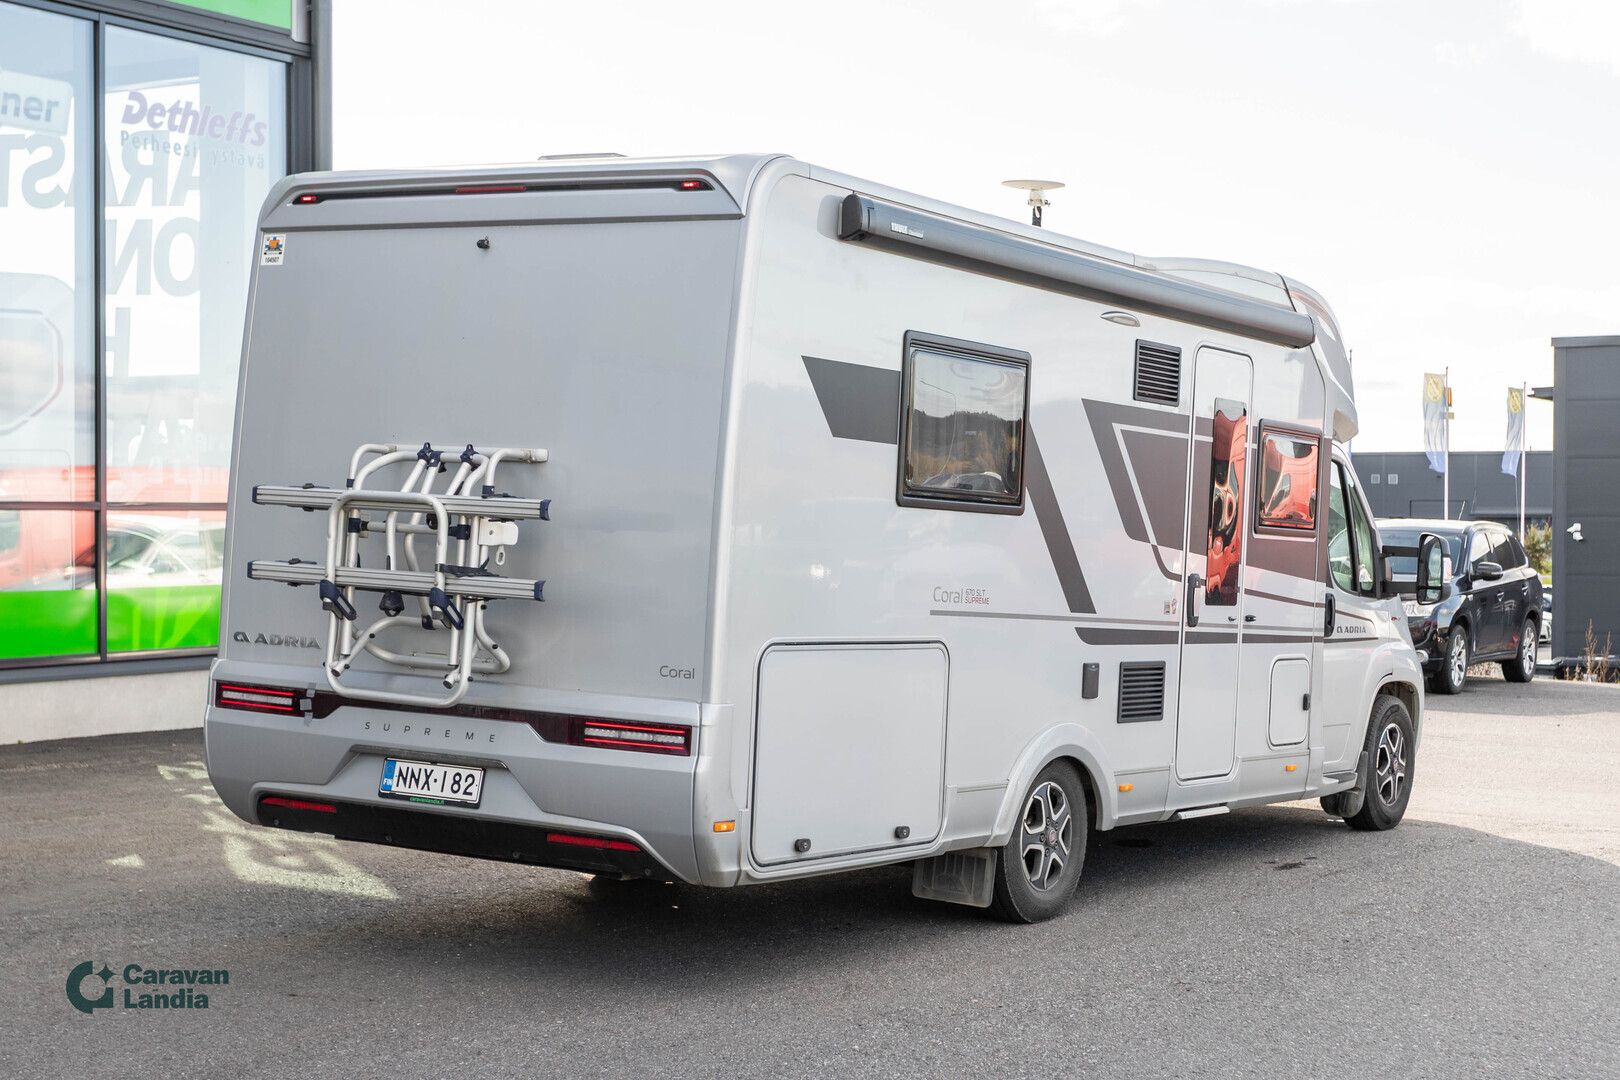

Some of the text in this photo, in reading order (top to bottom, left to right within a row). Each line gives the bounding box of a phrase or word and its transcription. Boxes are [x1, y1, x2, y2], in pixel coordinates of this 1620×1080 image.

[121, 90, 267, 147] Dethleffs
[934, 587, 963, 603] Coral
[964, 597, 990, 605] SUPREME
[255, 632, 322, 650] ADRIA
[660, 665, 695, 679] Coral
[364, 721, 496, 743] SUPREME
